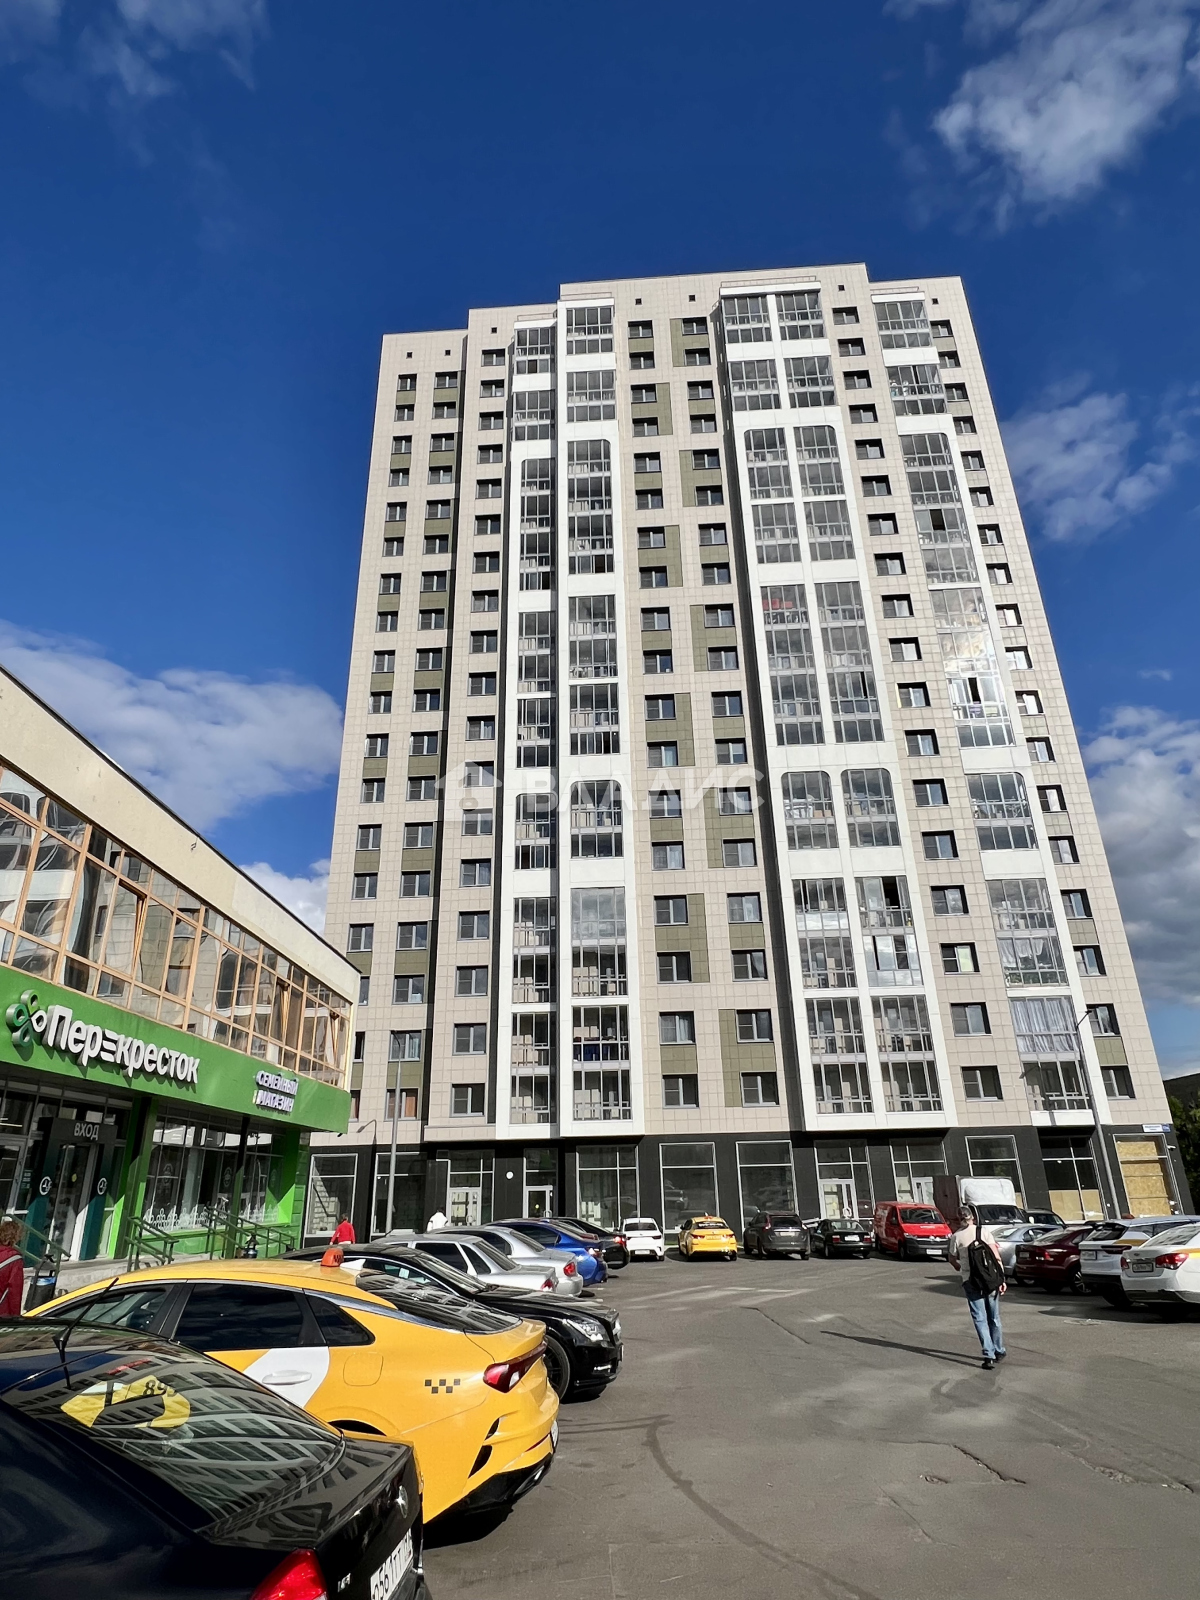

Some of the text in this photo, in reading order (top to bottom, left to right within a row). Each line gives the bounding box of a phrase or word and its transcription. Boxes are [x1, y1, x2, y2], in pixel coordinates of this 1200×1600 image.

[256, 1071, 299, 1095] СЕМЕЙНЫЙ
[255, 1090, 295, 1112] МАГАЗИН
[73, 1122, 100, 1141] ВХОД
